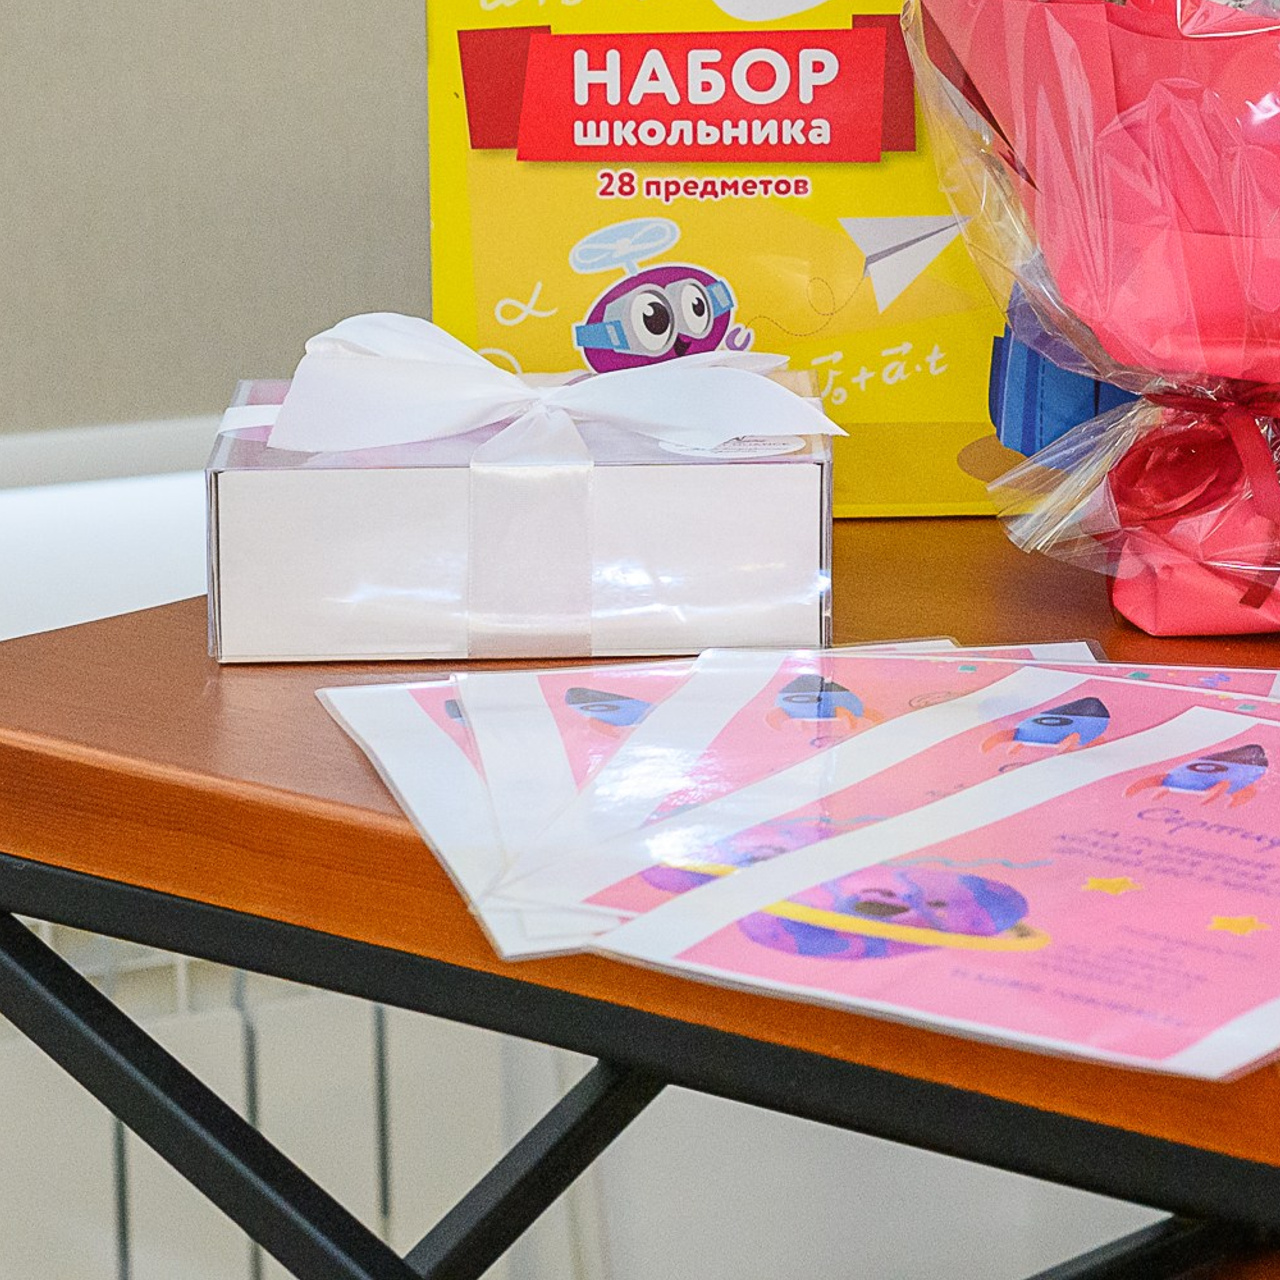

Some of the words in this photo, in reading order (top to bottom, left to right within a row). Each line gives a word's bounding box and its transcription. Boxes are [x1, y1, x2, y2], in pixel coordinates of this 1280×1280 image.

[573, 47, 840, 106] НАБОР
[573, 118, 831, 146] школьника
[598, 171, 636, 197] 28
[644, 176, 811, 203] предметов
